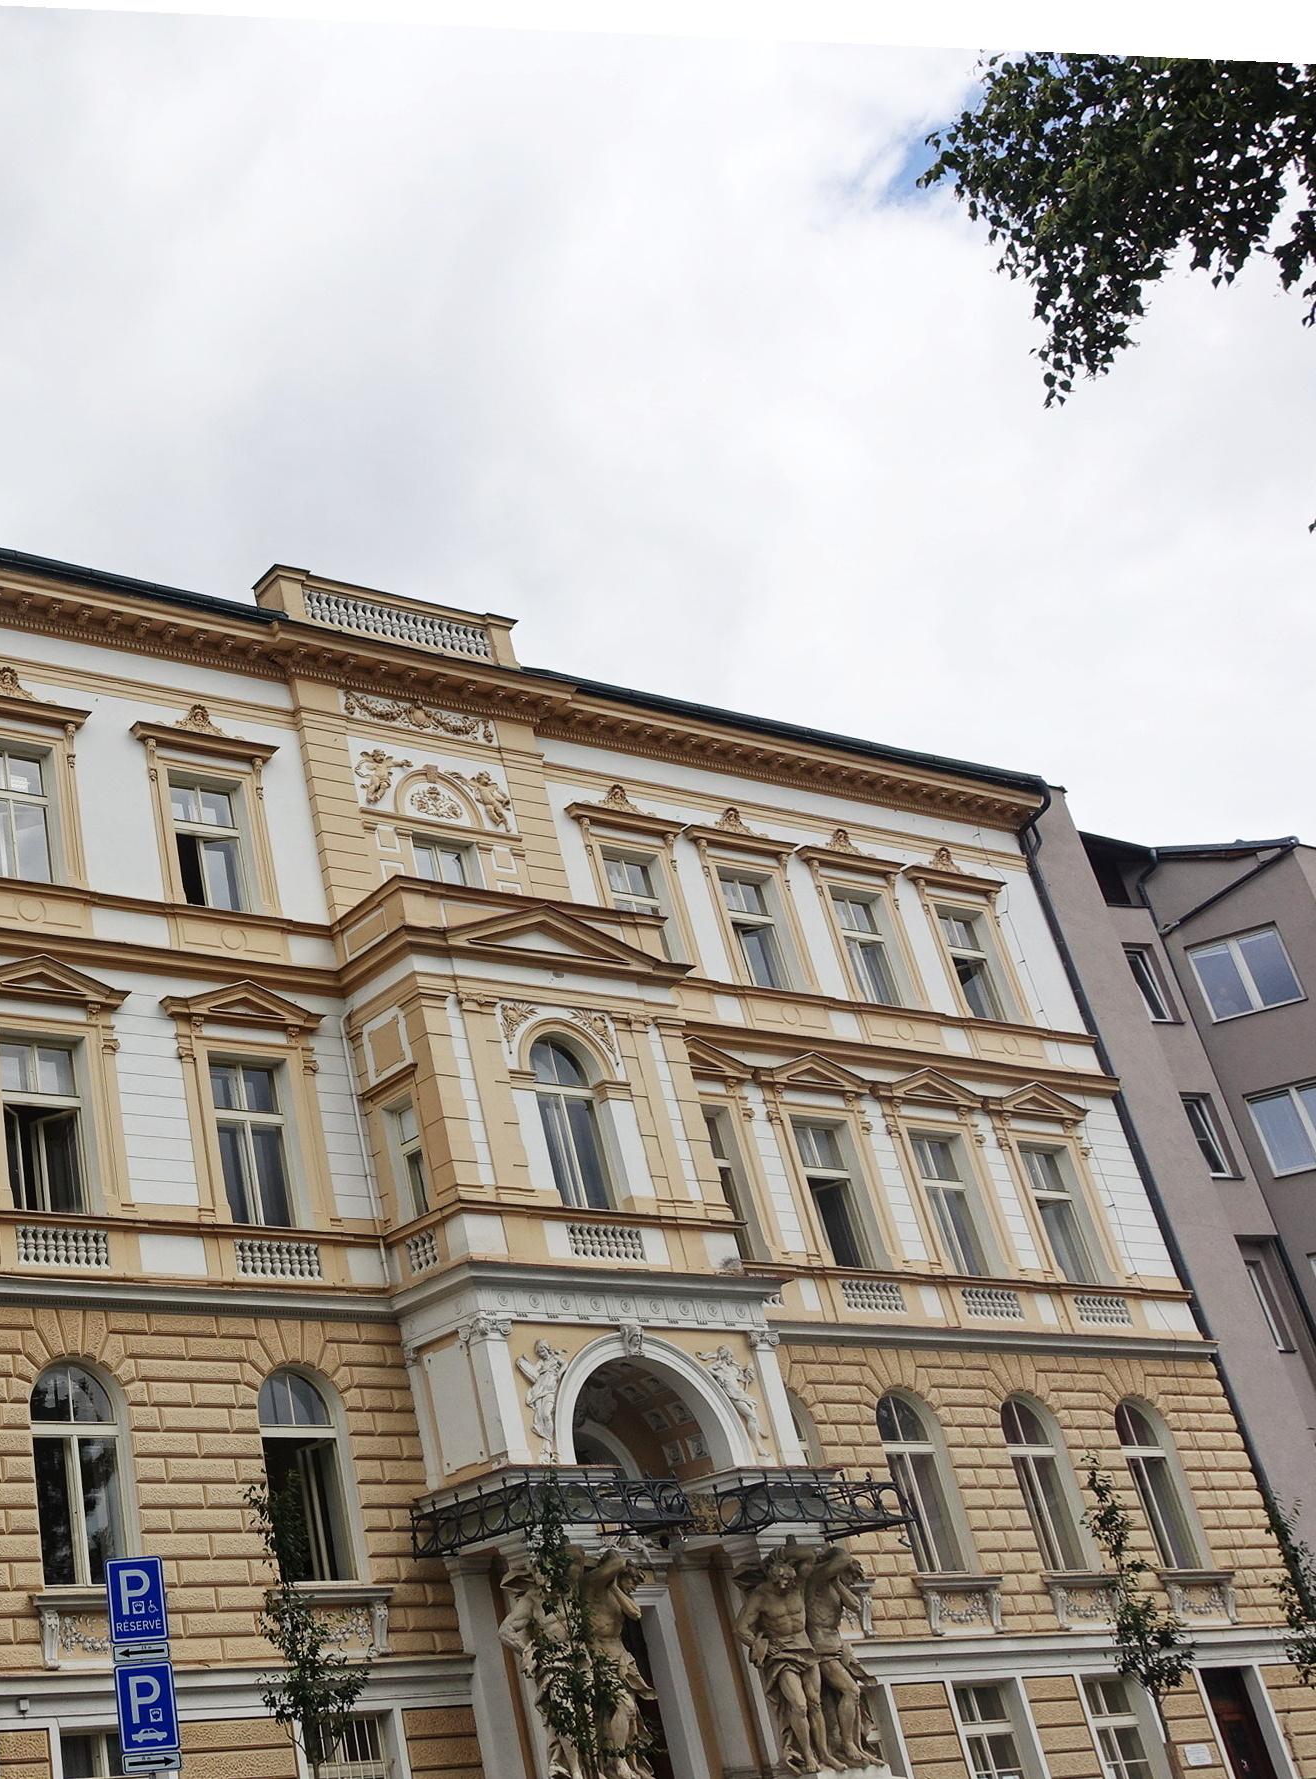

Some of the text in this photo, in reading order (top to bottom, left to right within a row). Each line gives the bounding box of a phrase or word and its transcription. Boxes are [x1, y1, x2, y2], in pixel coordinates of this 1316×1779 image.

[119, 1569, 150, 1615] P
[116, 1617, 162, 1632] RÉSERVÉ
[128, 1675, 161, 1724] P
